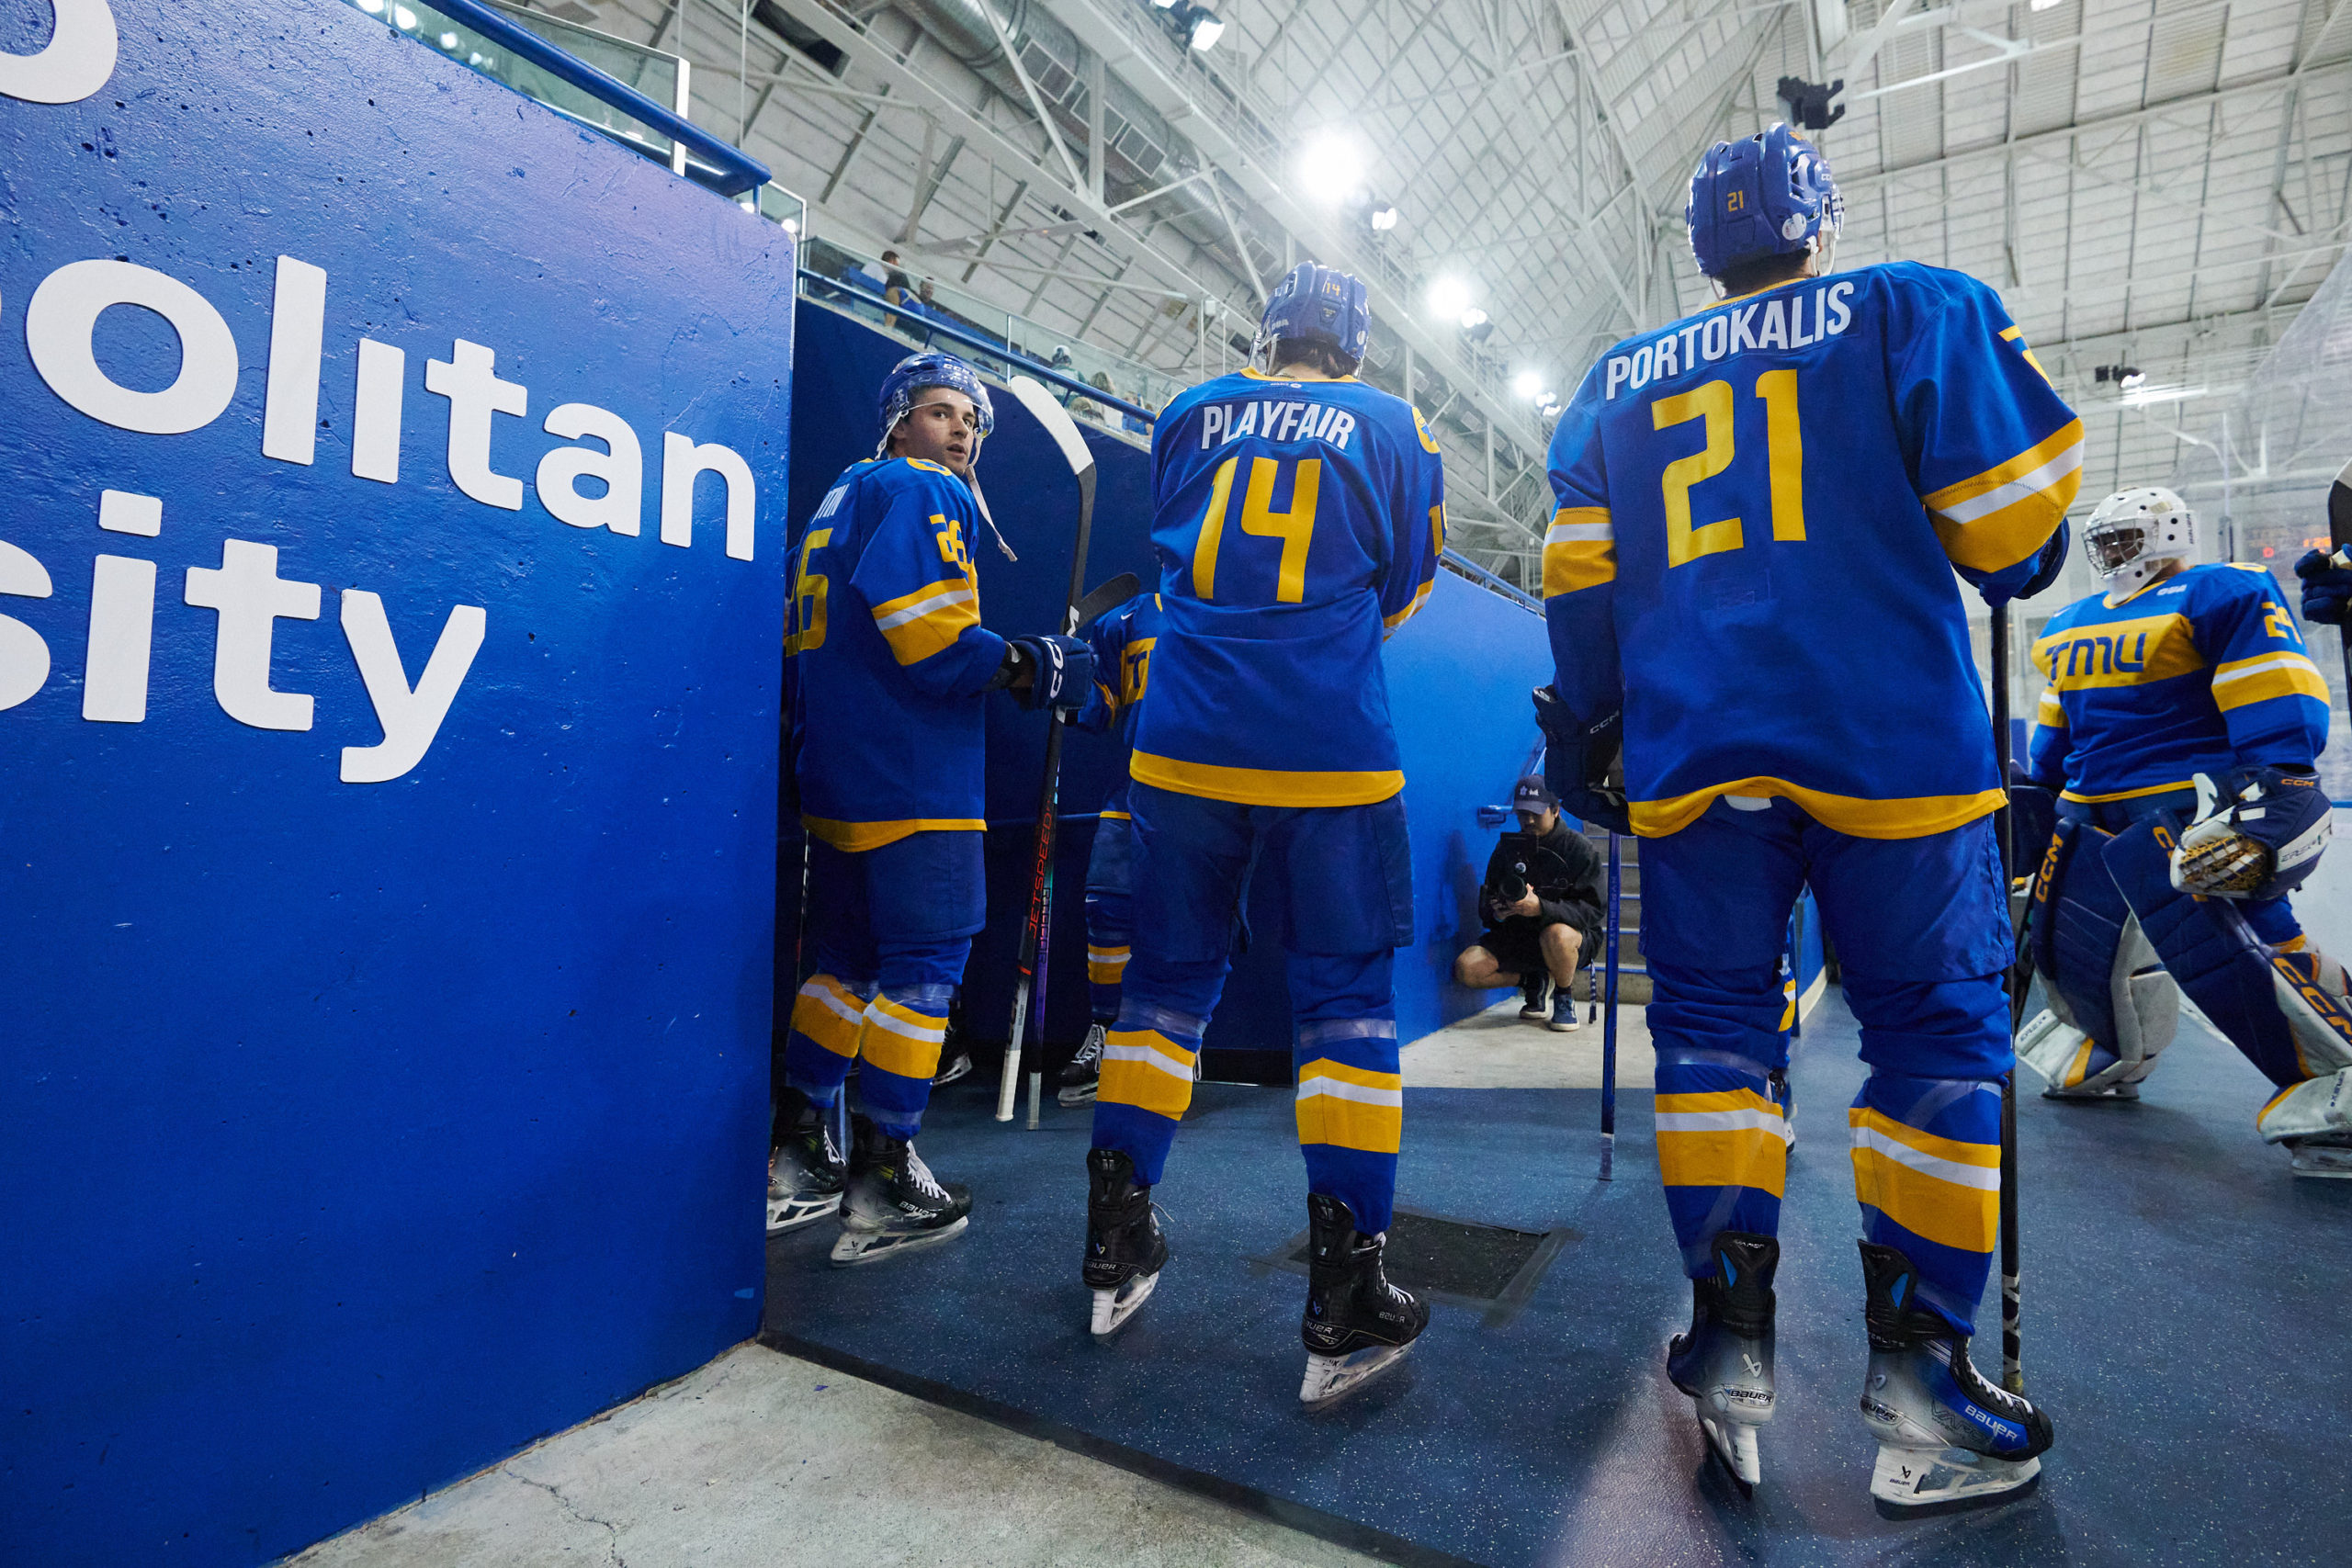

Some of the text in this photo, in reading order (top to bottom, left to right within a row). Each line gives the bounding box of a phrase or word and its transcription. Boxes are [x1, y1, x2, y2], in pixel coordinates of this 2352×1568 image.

[1727, 190, 1745, 212] 21
[1326, 282, 1340, 297] 14
[1606, 281, 1854, 400] PORTOKALIS
[1201, 400, 1356, 450] PLAYFAIR
[1652, 368, 1806, 569] 21
[929, 513, 968, 573] 26
[1193, 456, 1322, 604] 14
[1040, 636, 1064, 700] CC
[2045, 632, 2148, 682] TMU
[2280, 778, 2315, 787] CCM
[1028, 812, 1053, 940] JETSPEED
[2035, 832, 2064, 904] CCM
[1378, 1312, 1406, 1324] BAUR
[1729, 1390, 1773, 1404] BAUER
[1964, 1404, 2018, 1442] BAUER
[1889, 1478, 1911, 1486] BAUER
